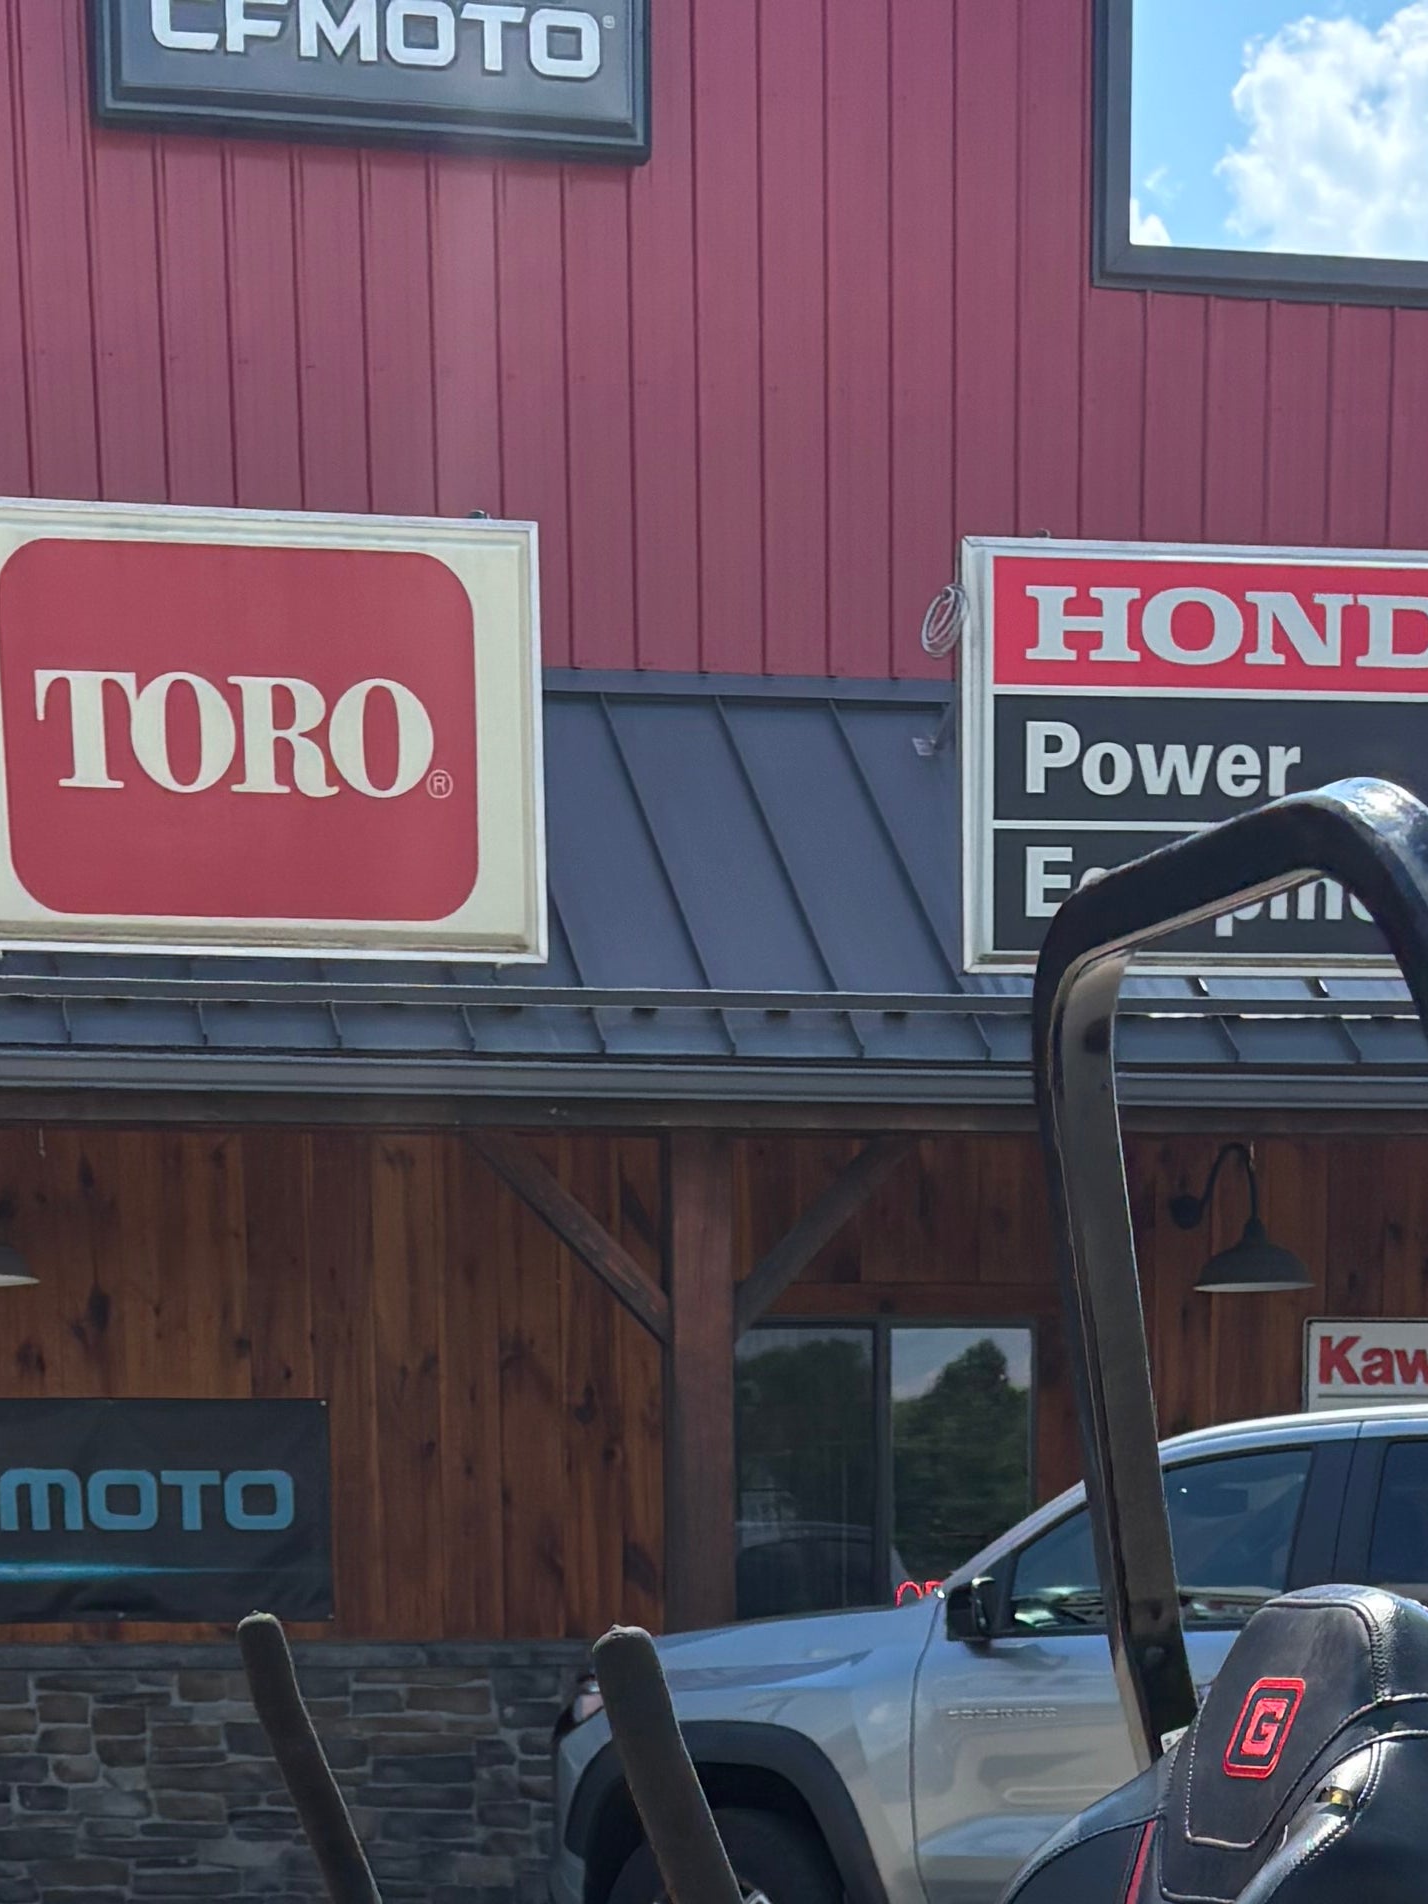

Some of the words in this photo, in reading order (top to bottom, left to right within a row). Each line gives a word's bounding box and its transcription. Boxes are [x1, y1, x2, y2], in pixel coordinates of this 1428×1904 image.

[151, 0, 602, 79] CFMOTO
[34, 668, 436, 799] TORO
[1024, 720, 1302, 798] Power
